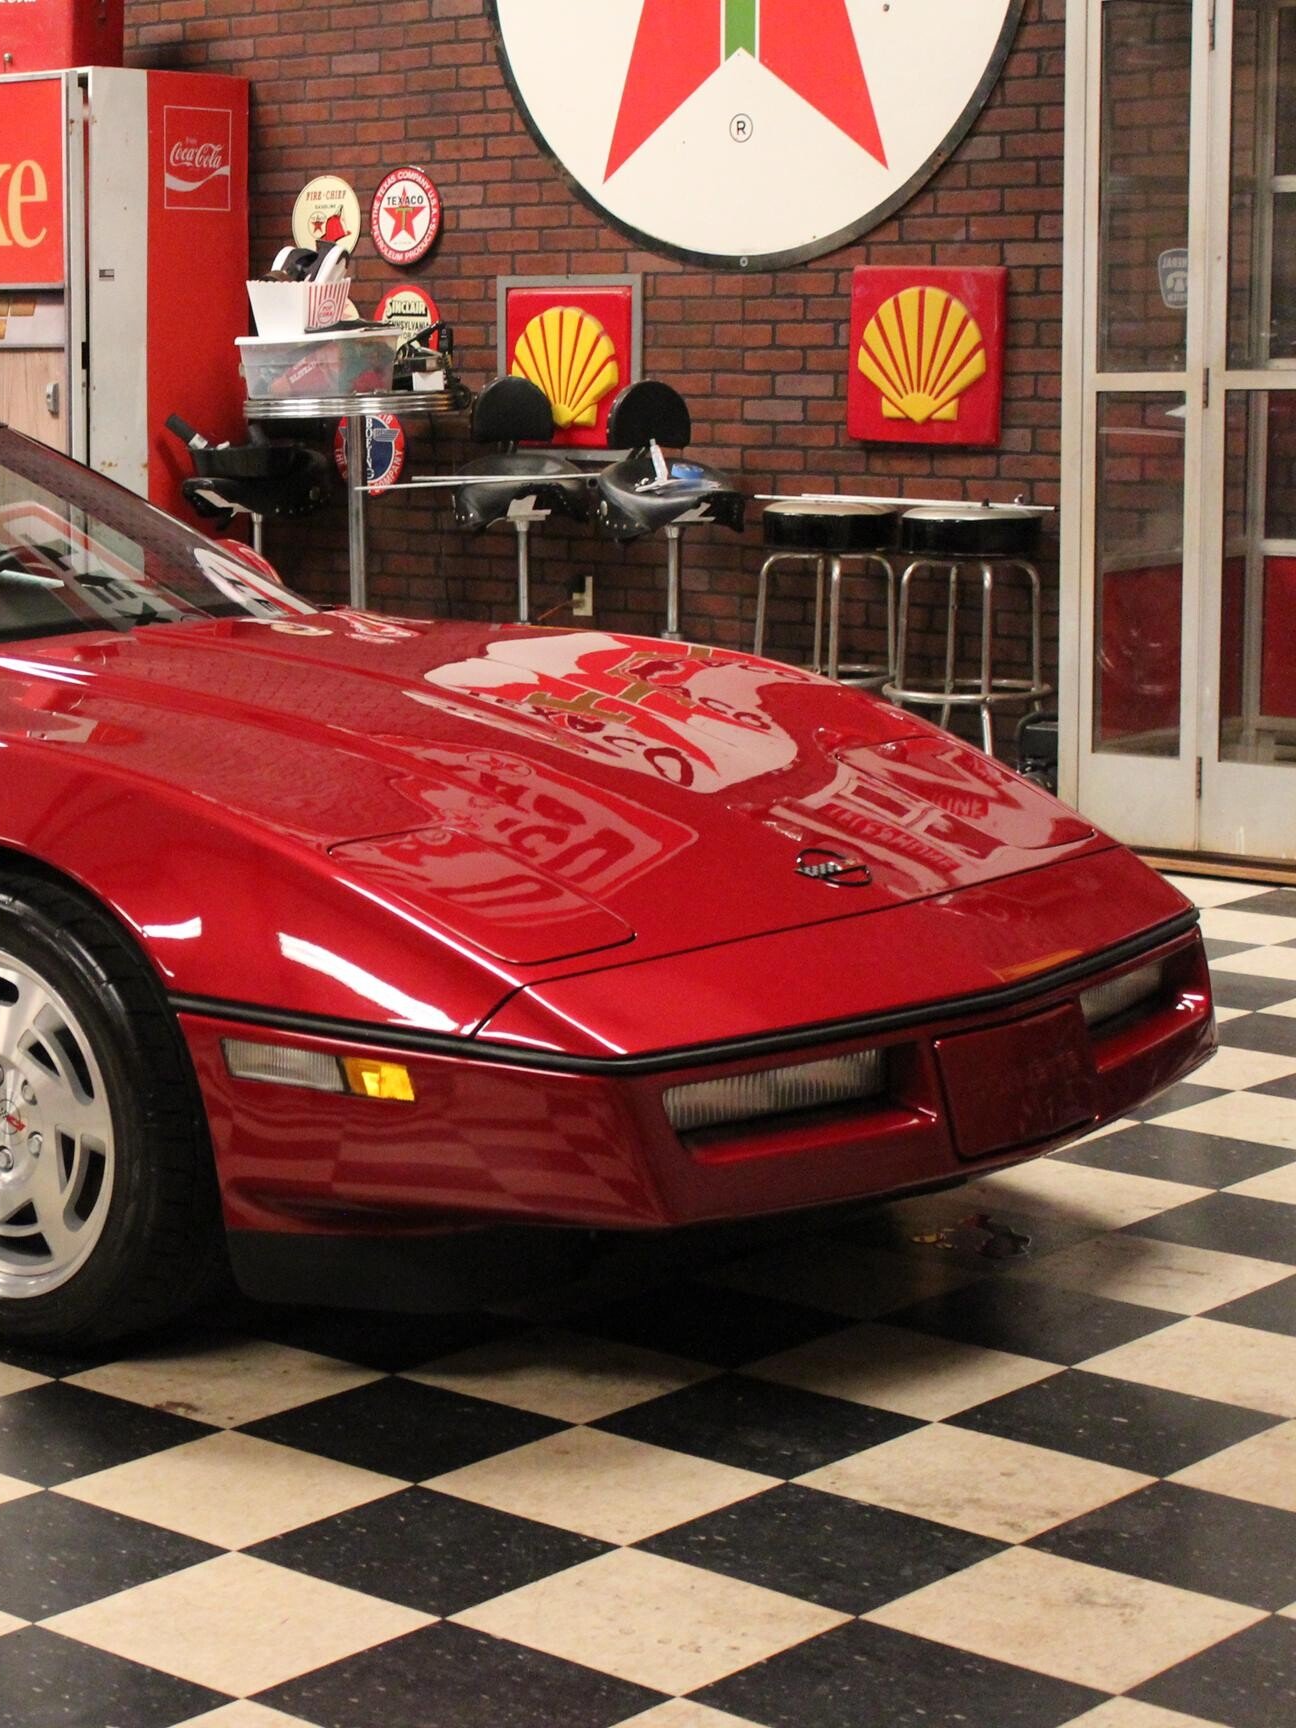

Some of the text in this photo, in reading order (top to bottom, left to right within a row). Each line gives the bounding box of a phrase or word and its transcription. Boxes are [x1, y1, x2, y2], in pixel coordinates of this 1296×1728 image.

[169, 141, 224, 168] Coca-Cola
[386, 195, 424, 206] TEXACO
[386, 299, 427, 318] SINCLAIR
